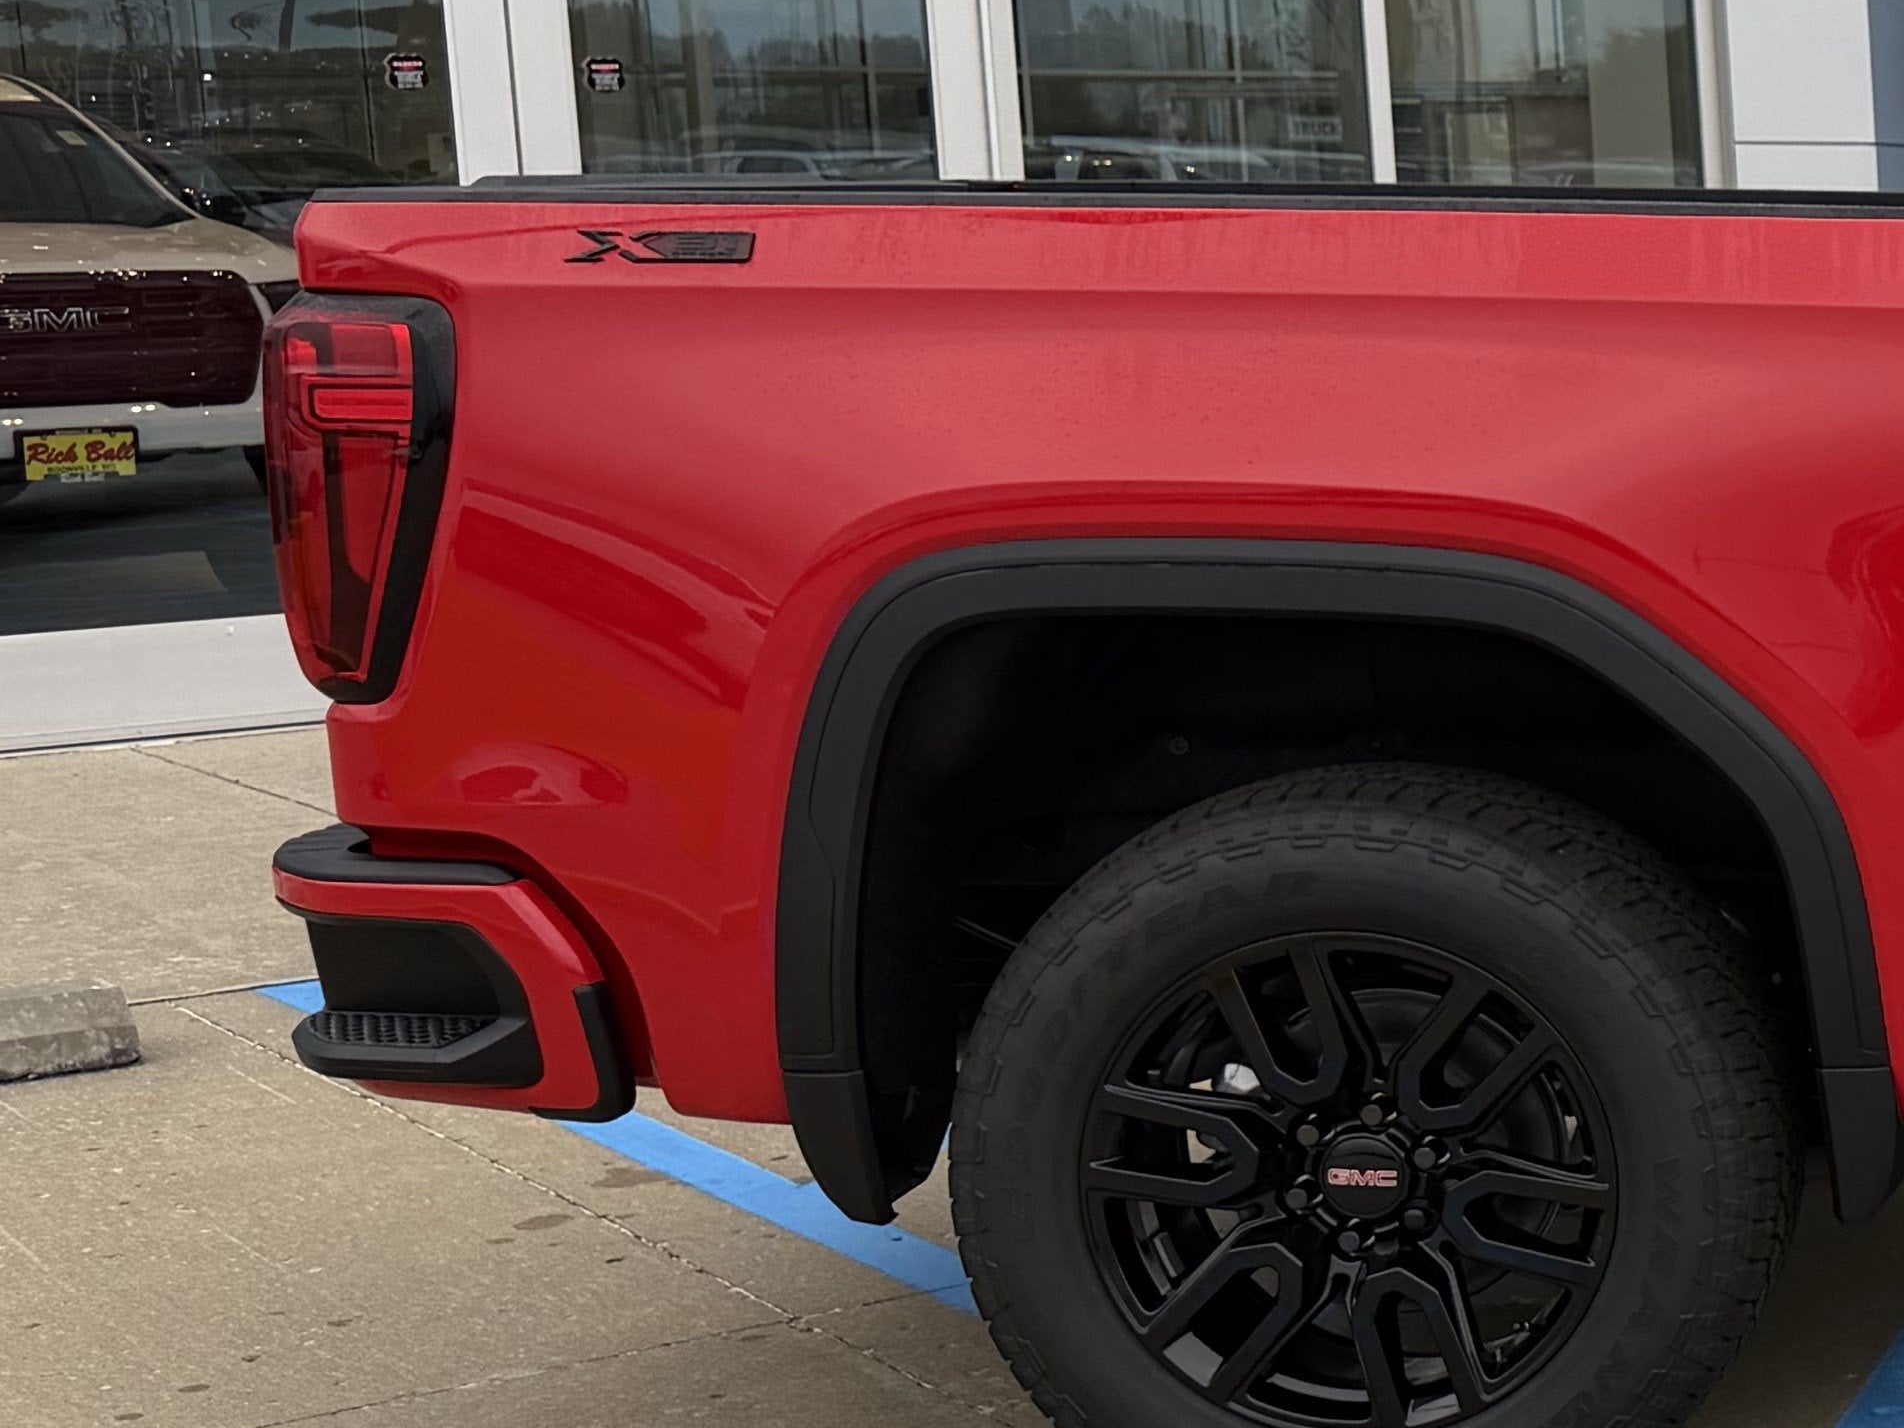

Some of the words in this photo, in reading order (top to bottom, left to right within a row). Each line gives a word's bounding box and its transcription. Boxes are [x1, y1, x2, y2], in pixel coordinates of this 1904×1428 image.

[26, 441, 79, 465] Rick
[84, 440, 135, 462] Ball
[1328, 1168, 1397, 1187] GMC
